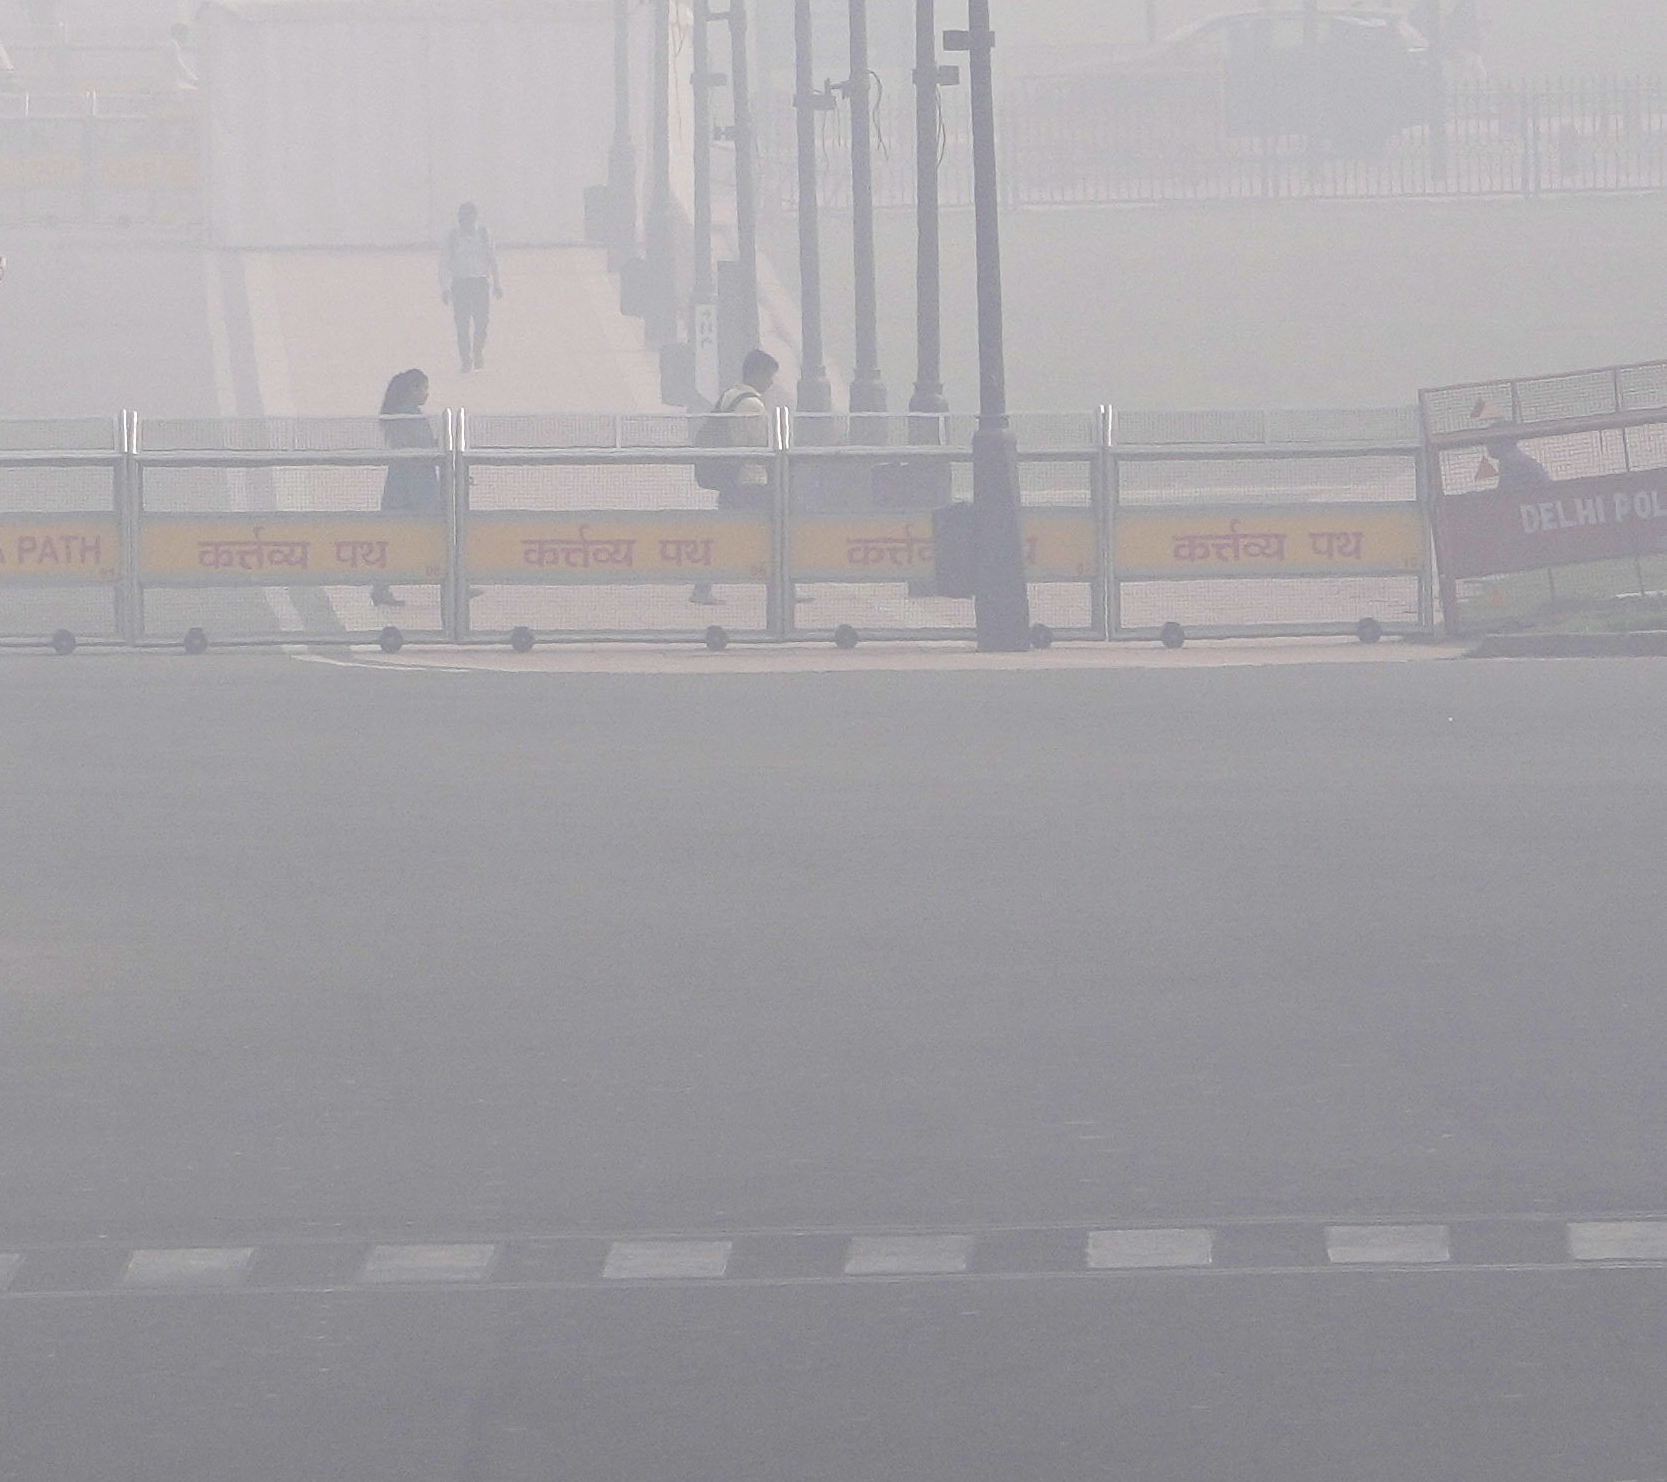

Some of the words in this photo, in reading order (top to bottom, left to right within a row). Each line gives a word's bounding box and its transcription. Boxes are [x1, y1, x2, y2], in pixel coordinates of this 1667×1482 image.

[1520, 496, 1606, 534] DELHI
[17, 534, 101, 565] PATH
[334, 540, 389, 570] पथ
[658, 538, 715, 567] पथ
[1309, 531, 1365, 561] पथ
